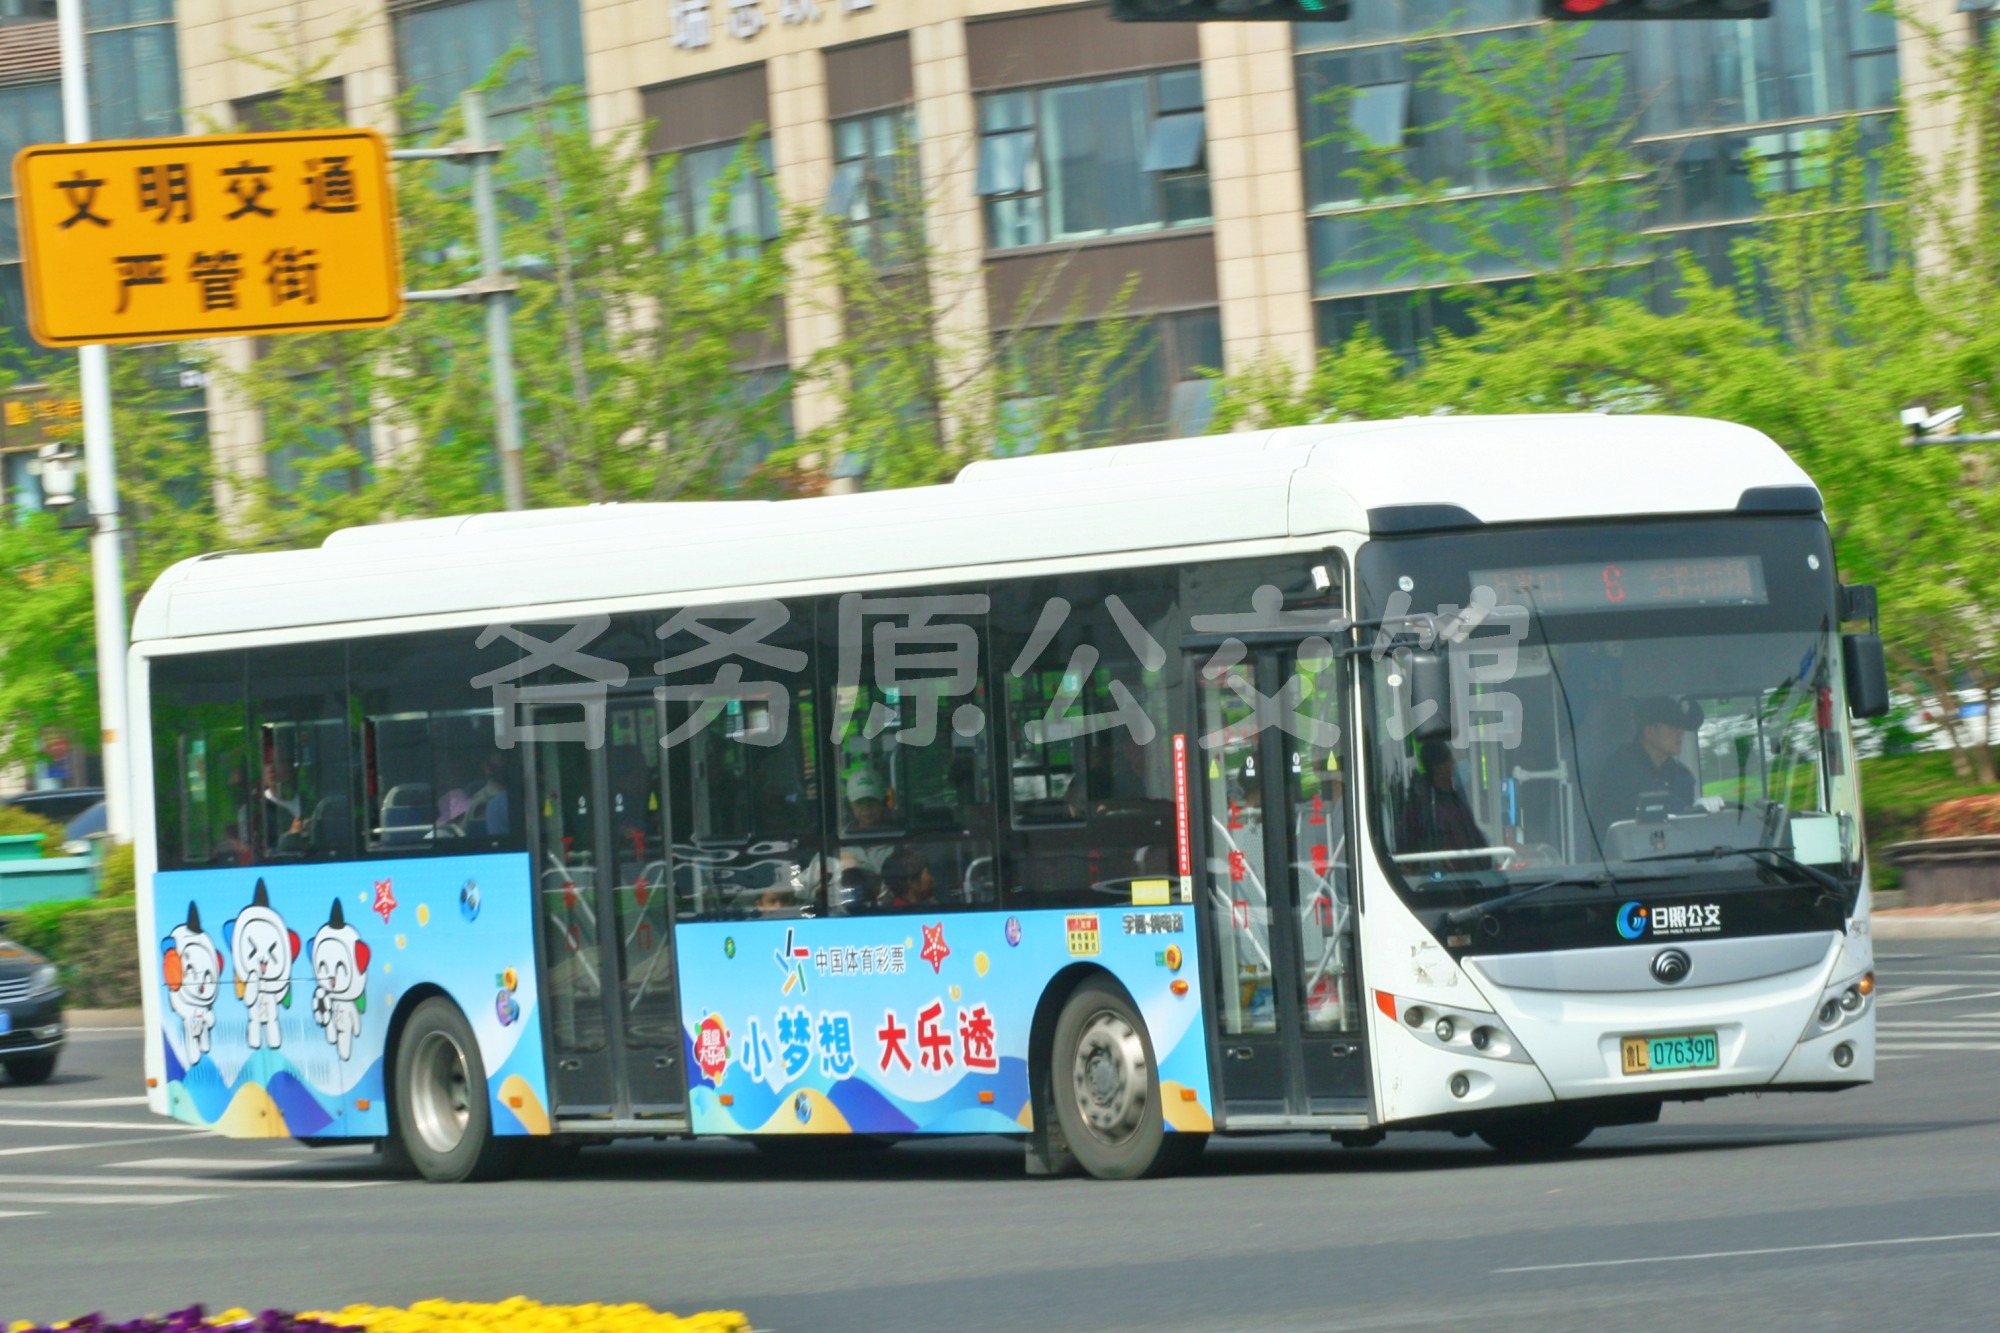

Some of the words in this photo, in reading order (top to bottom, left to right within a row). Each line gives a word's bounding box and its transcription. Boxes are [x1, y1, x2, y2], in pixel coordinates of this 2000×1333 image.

[54, 156, 360, 230] 文明交通
[113, 248, 322, 315] 严管街
[1603, 564, 1625, 602] 6
[1651, 904, 1720, 929] 日照公交
[815, 946, 905, 975] 中国体育彩票
[743, 1011, 855, 1077] 小梦想
[878, 1002, 997, 1072] 大乐透
